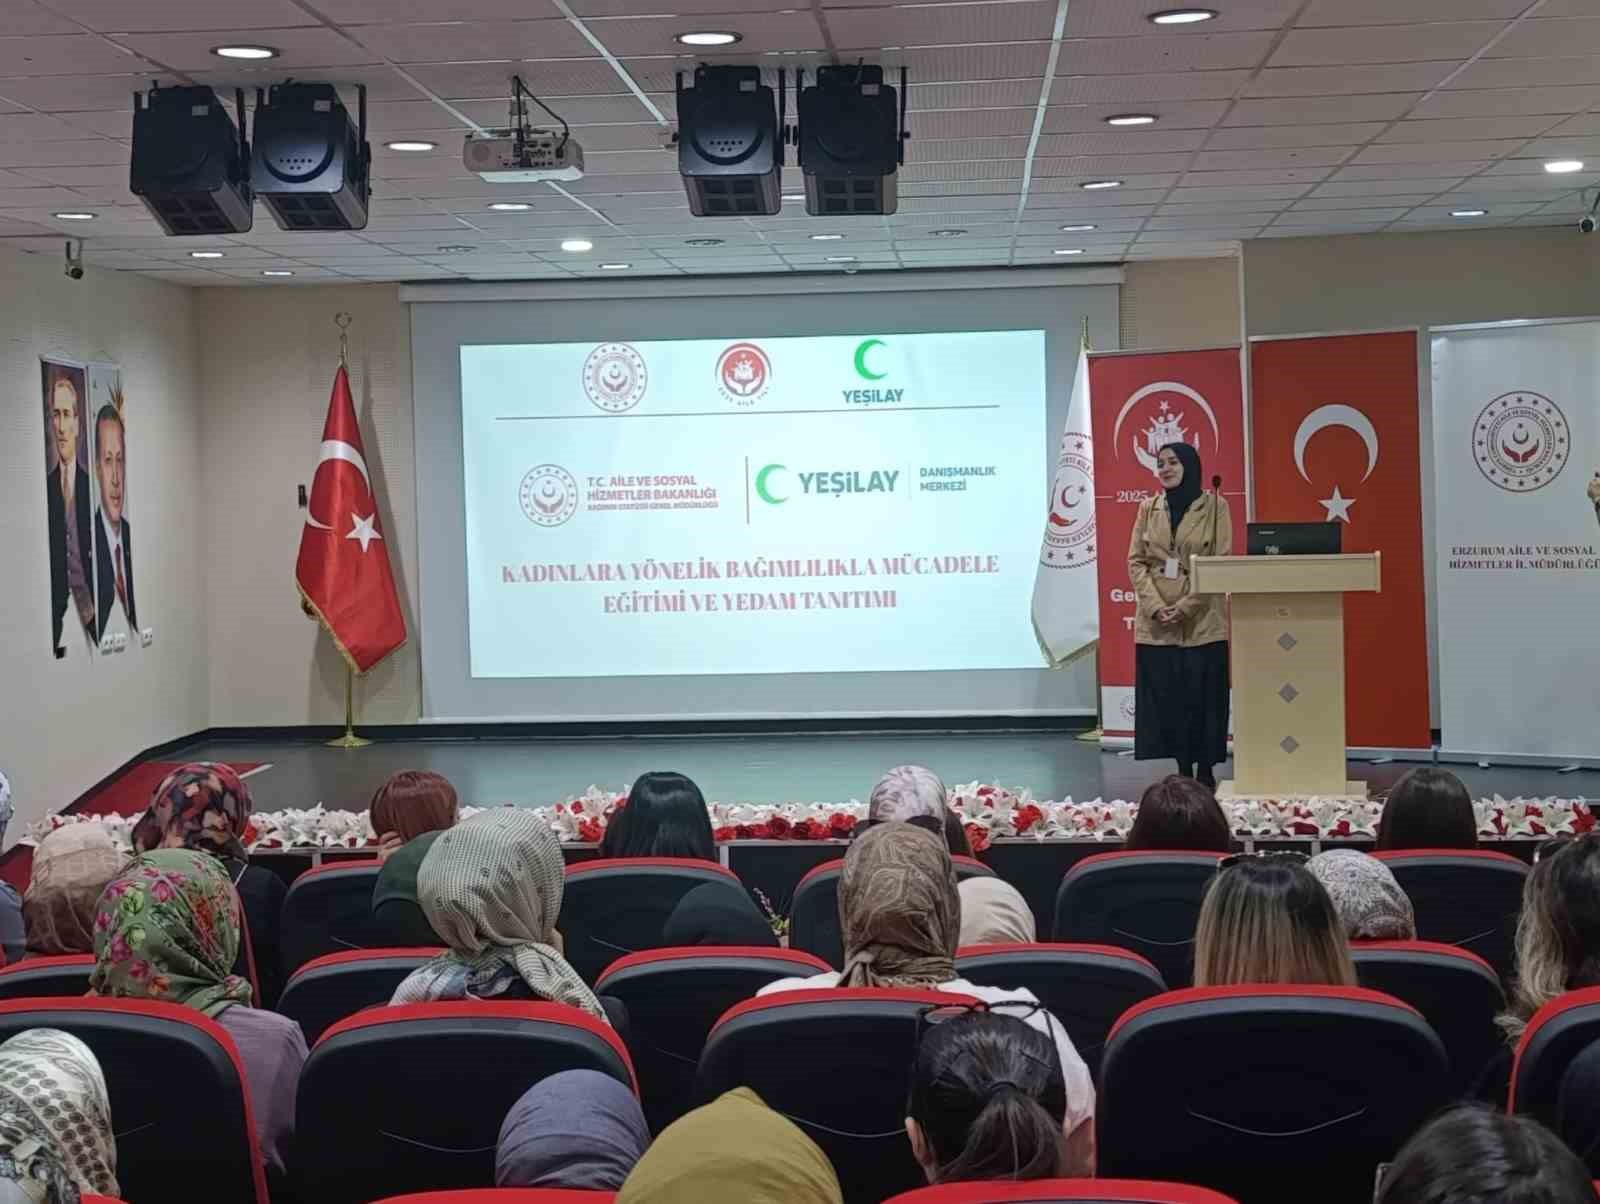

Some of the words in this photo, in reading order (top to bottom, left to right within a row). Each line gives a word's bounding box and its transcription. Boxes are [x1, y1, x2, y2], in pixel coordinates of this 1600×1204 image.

[637, 475, 651, 487] VE
[654, 474, 697, 486] SOSYAL
[919, 480, 967, 492] MERKEZİ
[587, 488, 652, 501] HİZMETLER
[654, 486, 717, 500] BAKANLIĞI
[1116, 490, 1149, 504] 2025
[1507, 543, 1534, 556] AİLE
[1535, 545, 1551, 556] VE
[1552, 545, 1597, 556] SOSYAL
[501, 562, 627, 584] KADINLARA
[631, 557, 721, 581] YÖNELİK
[726, 557, 878, 579] BAĞIMLILIKLA
[881, 553, 1000, 576] MÜCADELE
[1449, 558, 1513, 569] HİZMETLER
[603, 589, 687, 613] EĞİTİMİ
[690, 593, 719, 612] VE
[722, 592, 797, 612] YEDAM
[800, 590, 897, 609] TANITIMI
